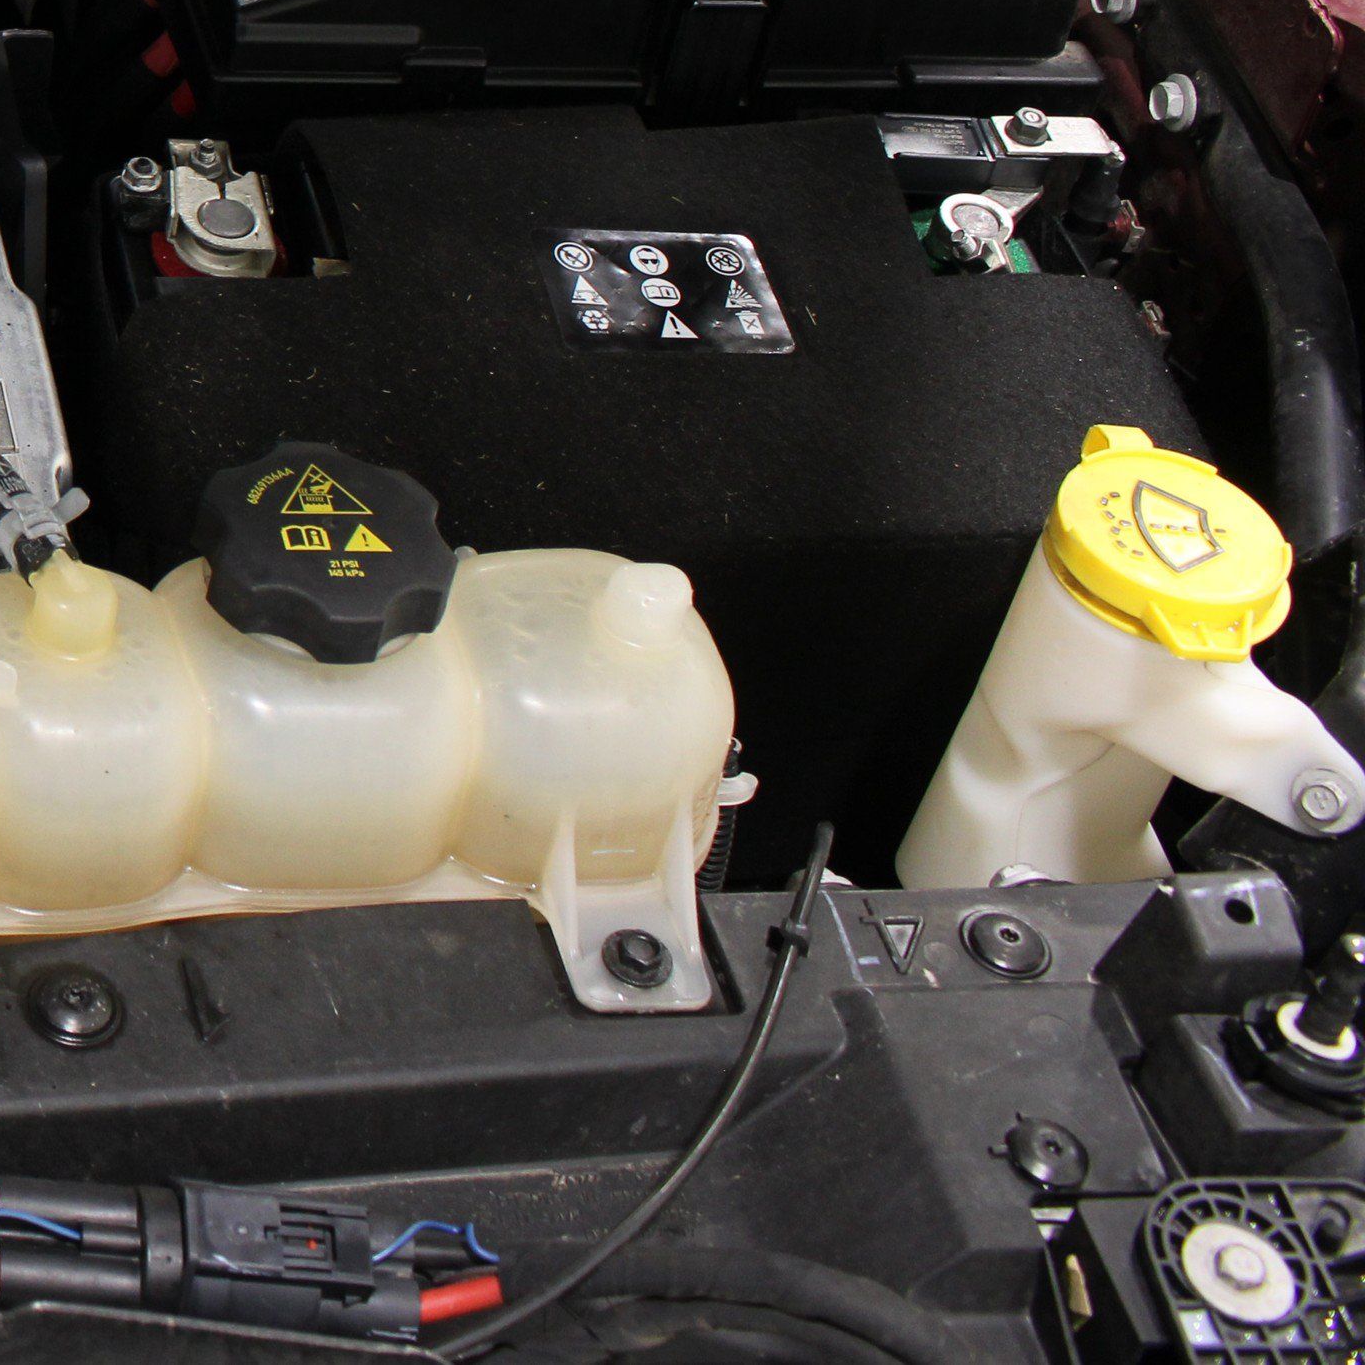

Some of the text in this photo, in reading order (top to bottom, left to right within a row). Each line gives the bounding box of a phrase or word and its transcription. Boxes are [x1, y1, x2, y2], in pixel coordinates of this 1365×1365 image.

[329, 559, 359, 568] 21 PSI
[344, 568, 365, 578] kPa
